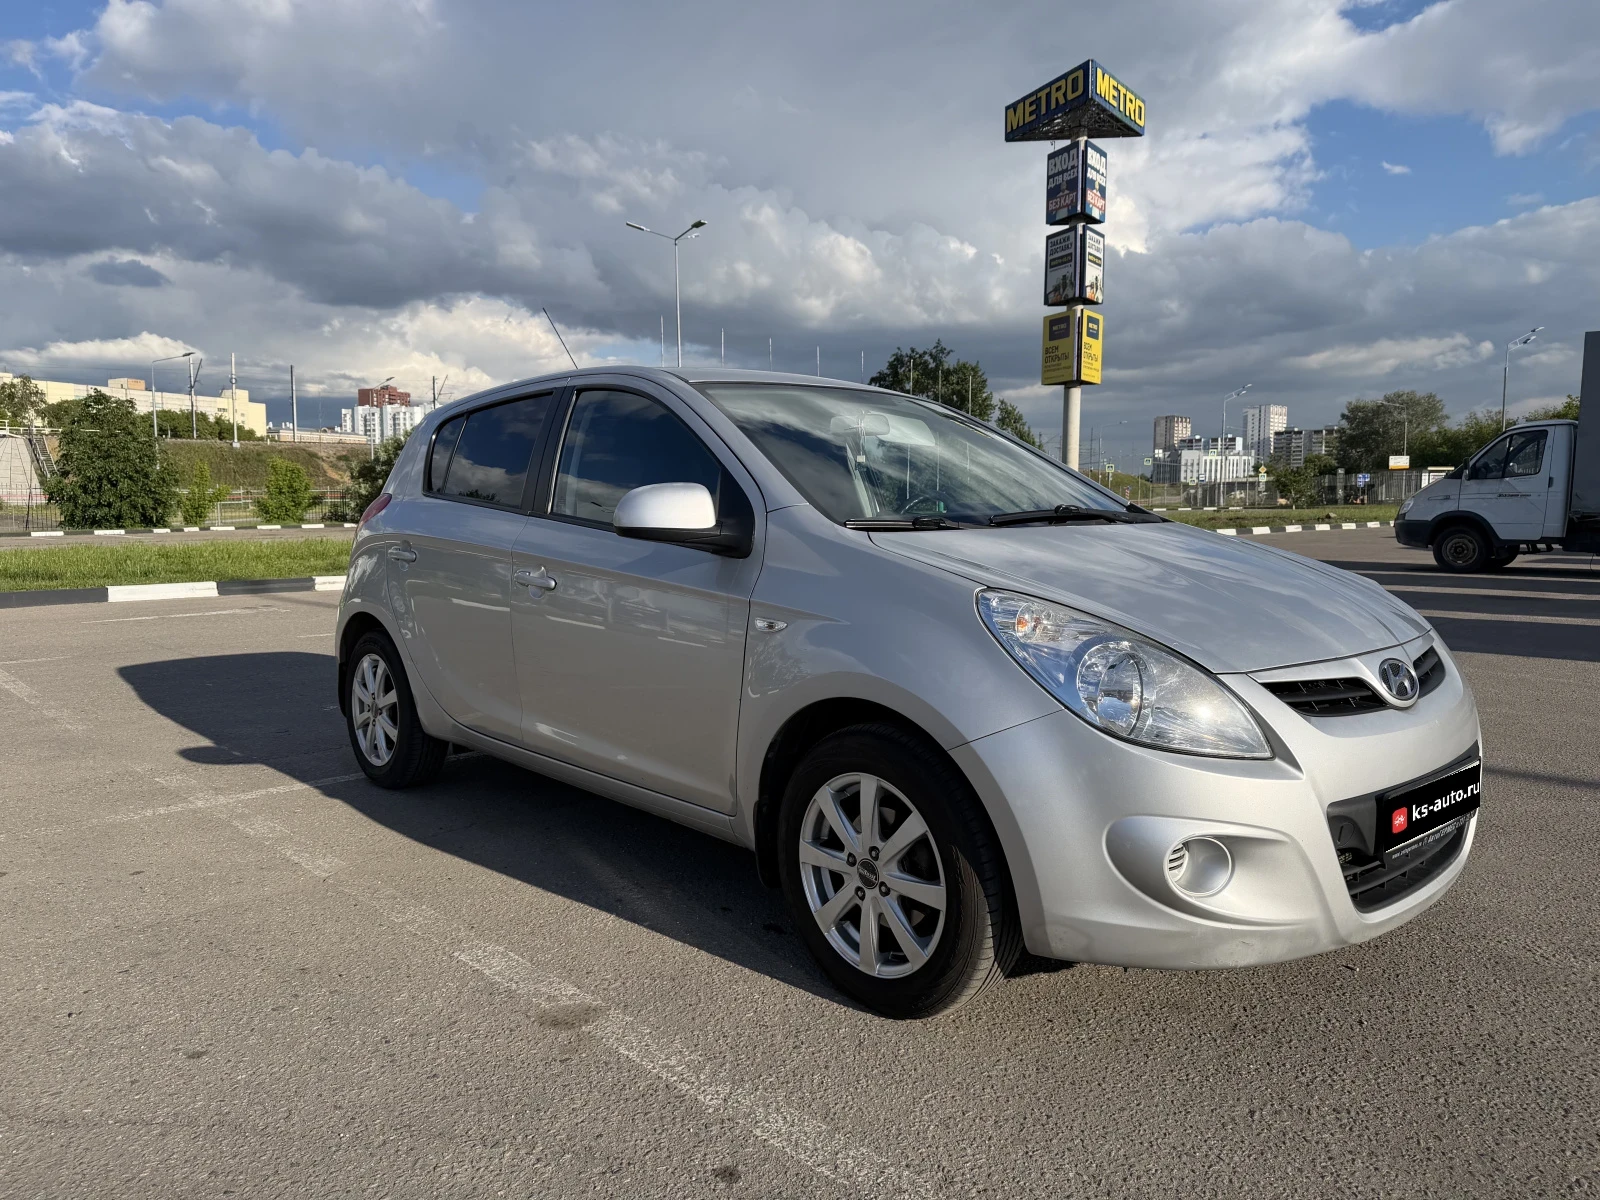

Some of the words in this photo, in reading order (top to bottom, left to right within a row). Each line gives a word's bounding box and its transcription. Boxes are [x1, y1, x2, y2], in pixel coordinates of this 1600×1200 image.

[1006, 68, 1084, 133] METRO
[1096, 67, 1145, 127] METRO
[1048, 147, 1078, 176] ВХОД
[1087, 146, 1106, 177] ВХОД
[1048, 174, 1062, 189] ДЛЯ
[1063, 168, 1078, 180] ВСЕХ
[1048, 198, 1060, 211] БЕЗ
[1061, 192, 1076, 207] КАРТ
[1049, 241, 1073, 256] ДОСТАВКУ
[1050, 235, 1070, 248] ЗАКАЖИ
[1045, 345, 1059, 355] ВСЕМ
[1045, 352, 1069, 364] ОТКРЫТЫ
[1083, 351, 1098, 362] ОТКРЫТЫ
